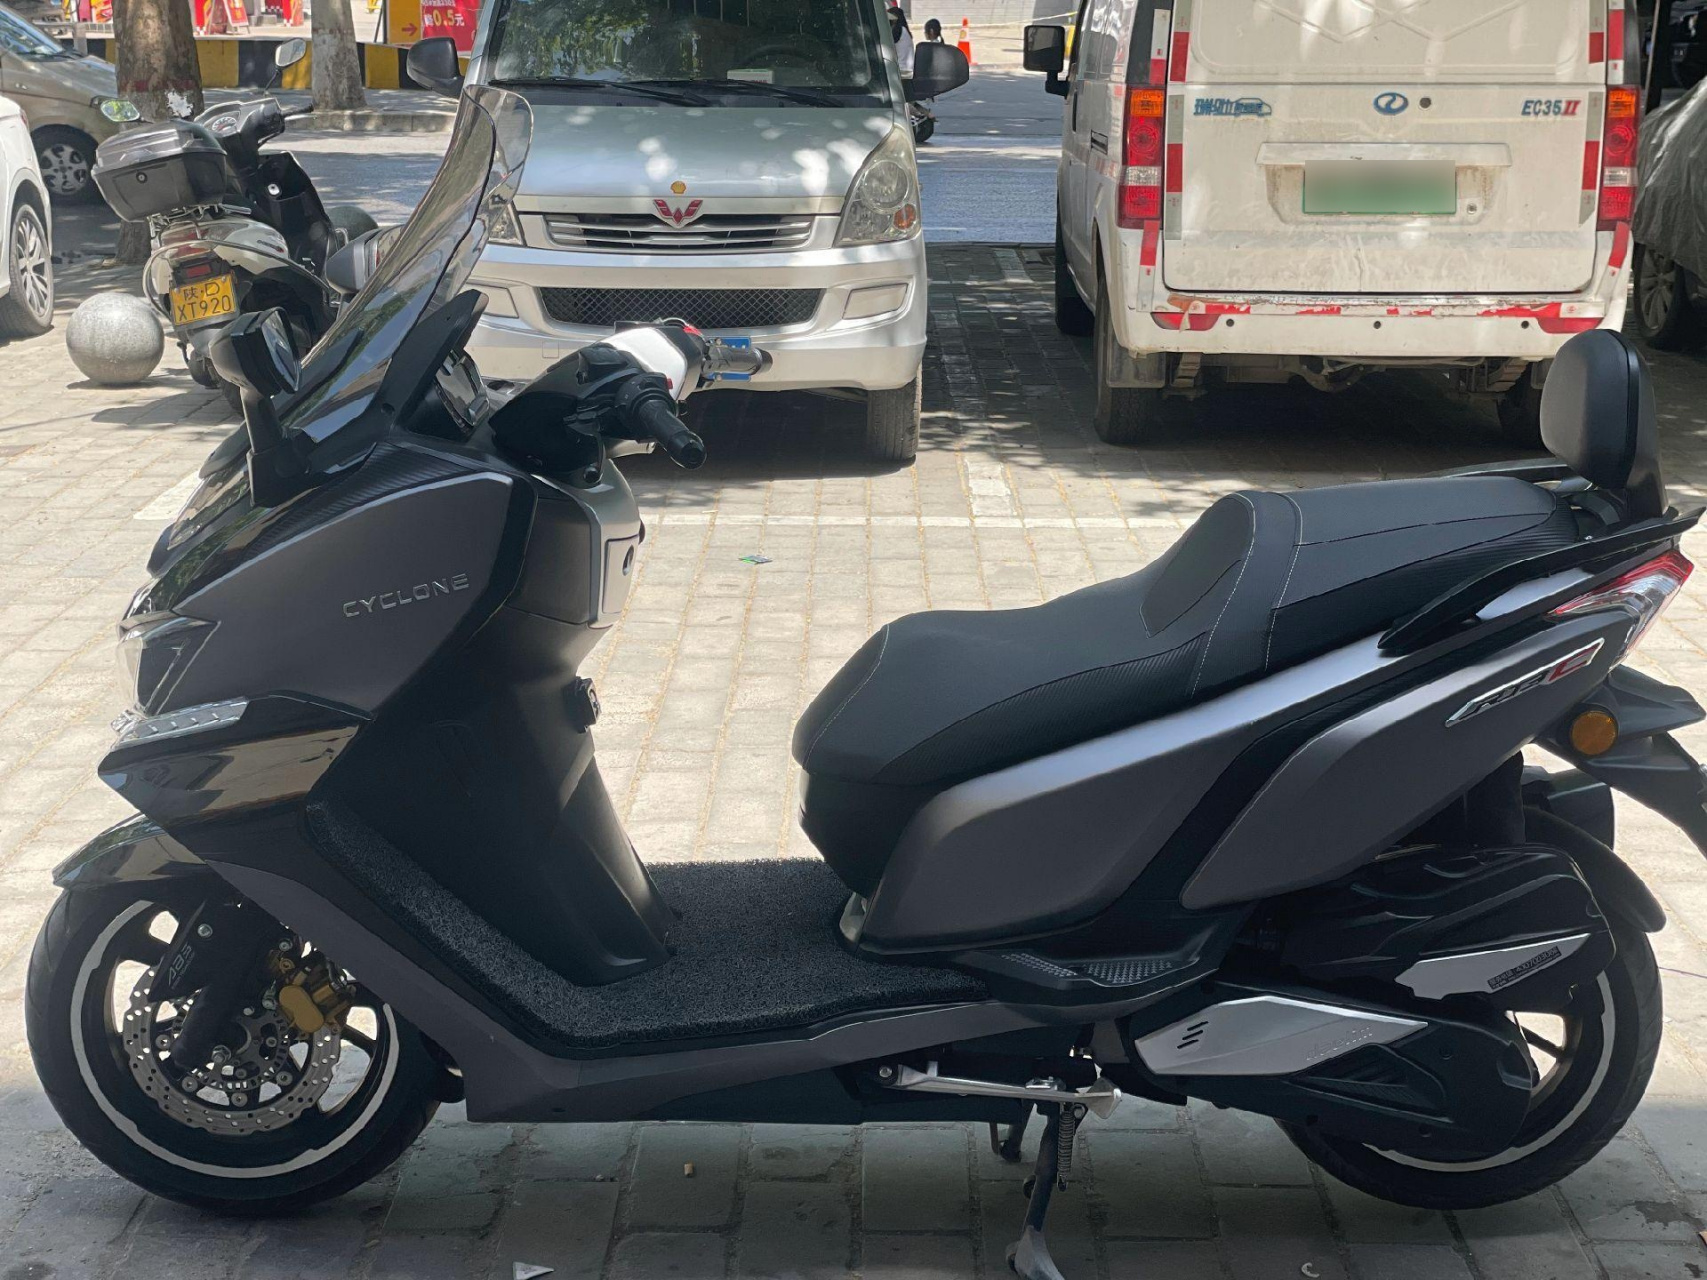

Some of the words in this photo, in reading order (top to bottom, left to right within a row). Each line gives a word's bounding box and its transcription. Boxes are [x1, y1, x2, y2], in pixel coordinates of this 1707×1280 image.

[177, 294, 232, 322] XT920
[343, 573, 469, 617] CYCLONE
[168, 941, 192, 986] ABS
